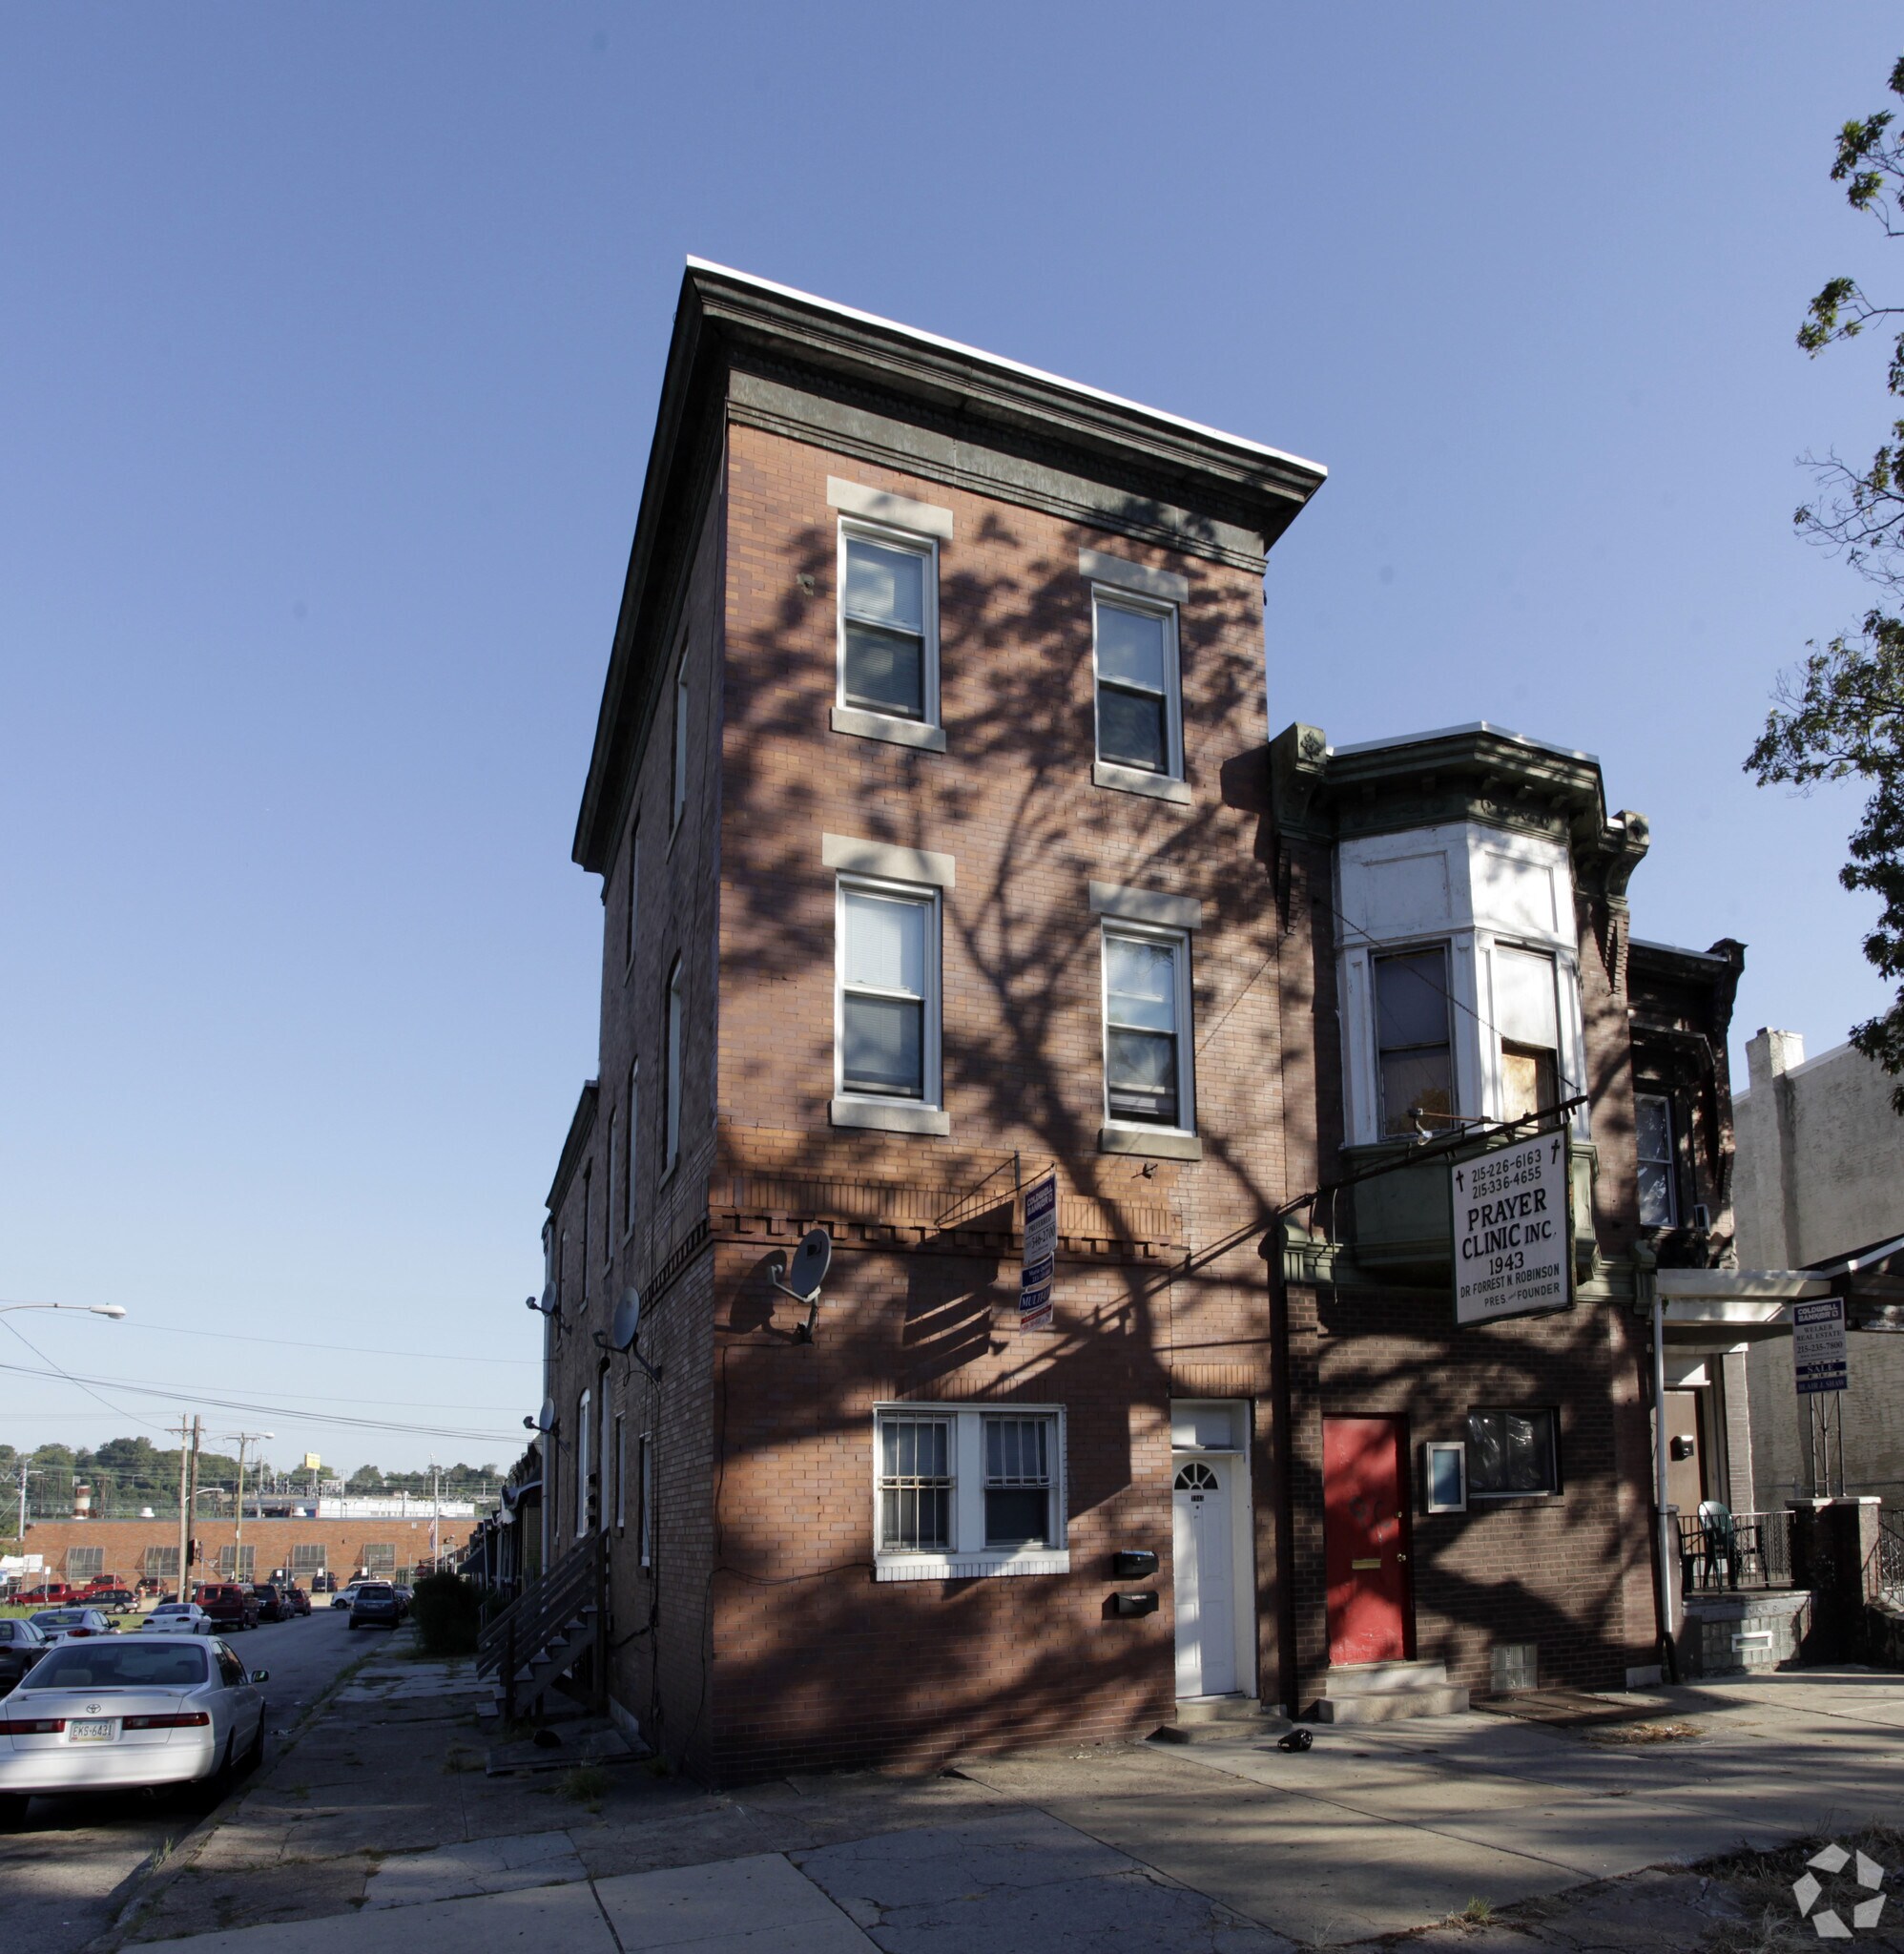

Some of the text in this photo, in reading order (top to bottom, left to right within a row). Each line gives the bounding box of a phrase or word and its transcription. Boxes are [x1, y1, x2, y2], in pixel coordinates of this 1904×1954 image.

[1472, 1149, 1542, 1183] 215-226-6163
[1473, 1166, 1542, 1199] 215-336-4655
[1467, 1188, 1547, 1232] PRAYER
[1462, 1220, 1557, 1259] CLINIC INC.
[1489, 1251, 1524, 1276] 1943
[1460, 1285, 1471, 1298] DR
[1473, 1276, 1504, 1295] FORREST
[1516, 1263, 1560, 1284] ROBINSON
[1517, 1282, 1561, 1300] FOUNDER
[1797, 1303, 1838, 1316] COLDWELL
[1798, 1311, 1831, 1322] BANKER
[1804, 1324, 1832, 1334] WELKER
[1815, 1330, 1841, 1340] ESTATE
[1807, 1363, 1833, 1374] SALE
